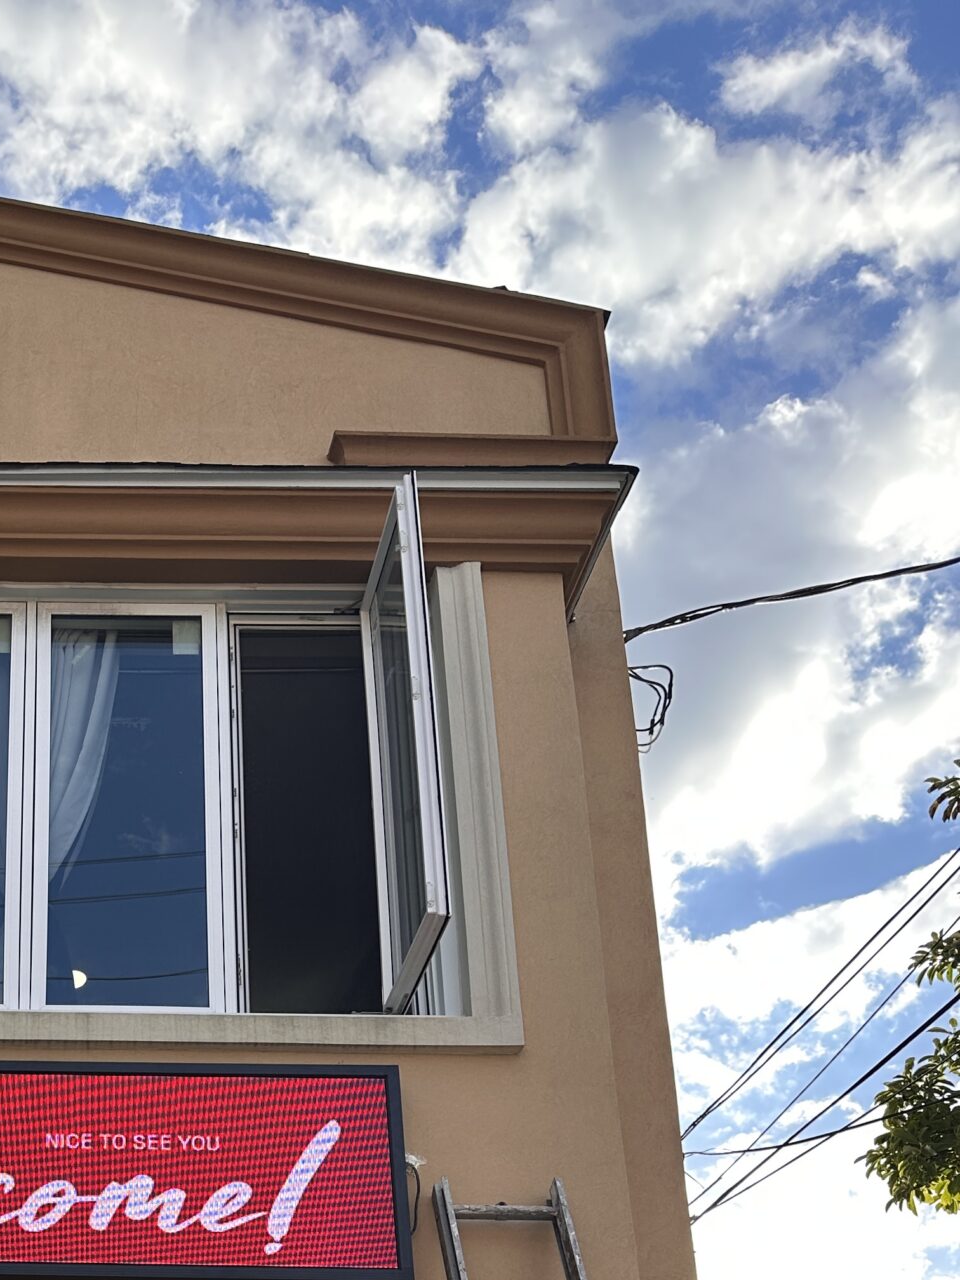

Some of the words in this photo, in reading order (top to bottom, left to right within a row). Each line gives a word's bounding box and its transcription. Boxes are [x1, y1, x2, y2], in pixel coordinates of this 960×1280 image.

[45, 1133, 92, 1149] NICE
[99, 1133, 127, 1150] TO
[133, 1134, 172, 1151] SEE
[177, 1135, 221, 1151] YOU
